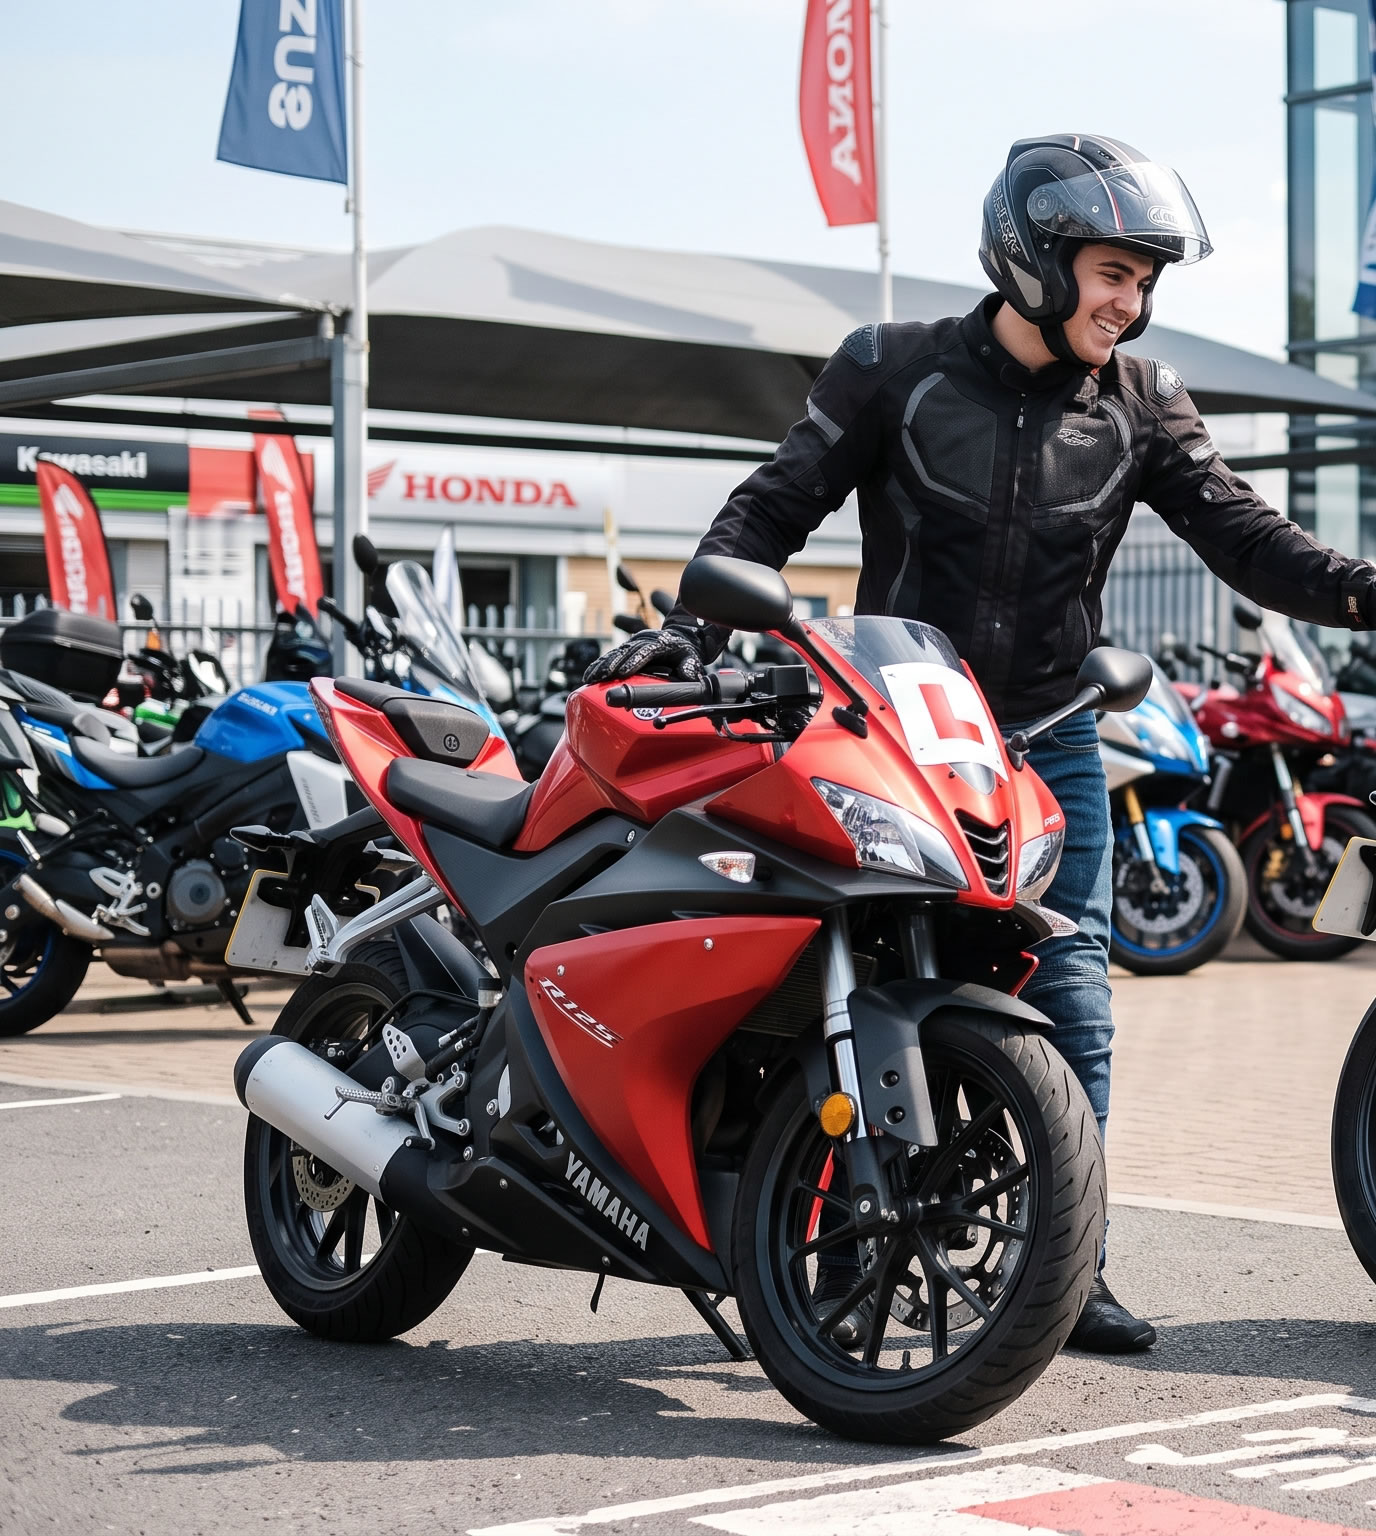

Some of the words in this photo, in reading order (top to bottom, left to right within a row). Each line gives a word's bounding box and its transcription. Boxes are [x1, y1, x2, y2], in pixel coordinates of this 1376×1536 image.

[403, 473, 577, 508] HONDA
[918, 684, 985, 745] L
[564, 1151, 650, 1251] YAMAHA
